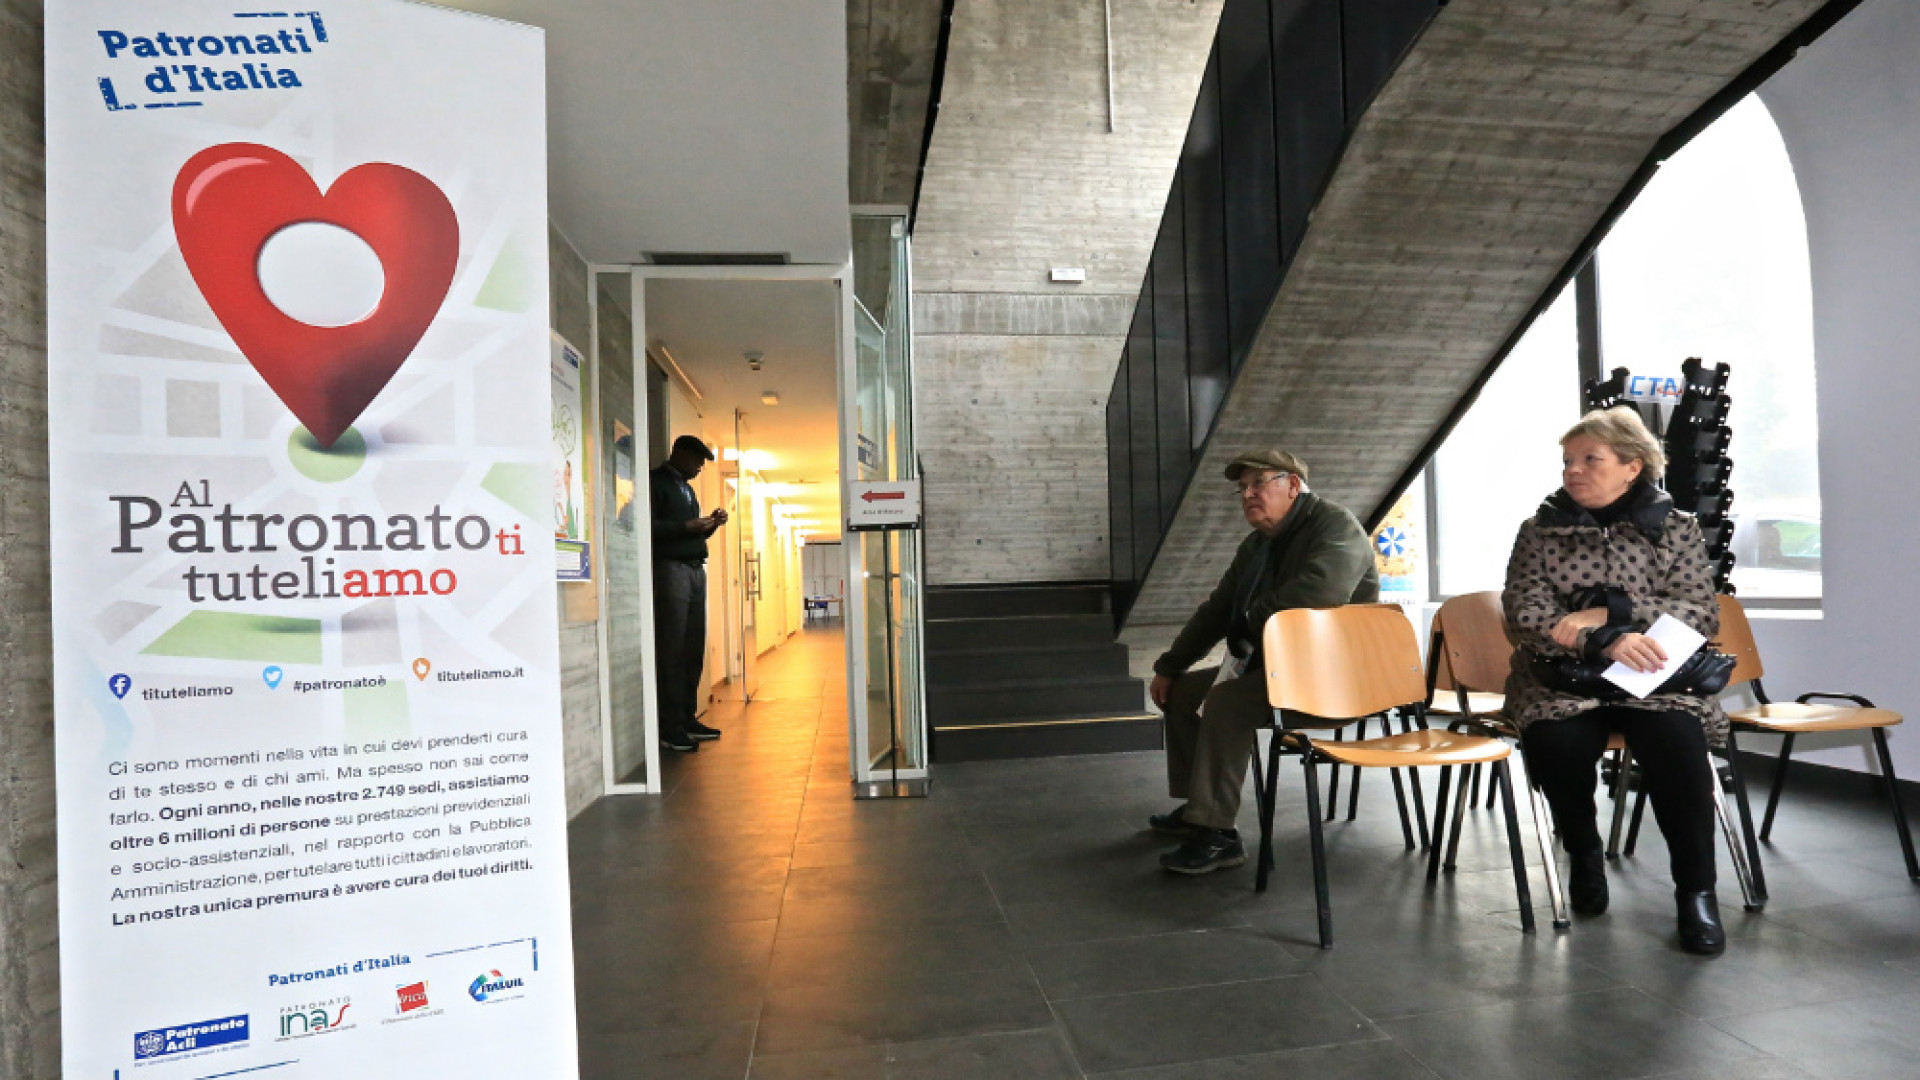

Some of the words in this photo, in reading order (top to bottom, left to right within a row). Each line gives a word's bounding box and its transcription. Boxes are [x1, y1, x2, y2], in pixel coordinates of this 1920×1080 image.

[98, 27, 311, 58] Patronati
[144, 62, 302, 94] d'Italia
[1630, 376, 1679, 397] CTA
[171, 479, 213, 507] Al
[109, 495, 491, 554] Patronato
[495, 524, 525, 555] ti
[182, 556, 458, 602] tuteliamo
[142, 683, 234, 700] tituteliamo
[293, 675, 387, 696] #patronatoè
[437, 667, 525, 682] tituteliamo.it
[109, 761, 128, 775] Ci
[134, 760, 179, 774] sono
[185, 750, 260, 770] momenti
[266, 747, 304, 763] nella
[309, 745, 339, 759] vita
[343, 743, 357, 755] in
[363, 740, 387, 754] cui
[391, 737, 423, 751] devi
[427, 731, 493, 750] prenderti
[497, 730, 528, 742] cura
[109, 787, 126, 801] di
[134, 786, 151, 799] te
[159, 780, 217, 796] stesso
[225, 779, 235, 789] e
[242, 775, 258, 788] di
[264, 771, 289, 786] chi
[296, 769, 329, 783] ami.
[337, 766, 362, 780] Ma
[368, 761, 423, 778] spesso
[430, 758, 457, 770] non
[463, 754, 483, 767] sai
[489, 752, 529, 765] come
[109, 810, 155, 826] farlo.
[159, 804, 203, 821] Ogni
[207, 802, 257, 816] anno,
[260, 795, 302, 811] nelle
[305, 789, 359, 806] nostre
[362, 784, 405, 800] 2.749
[409, 780, 446, 795] sedi,
[448, 774, 529, 791] assistiamo
[110, 835, 154, 850] oltre
[159, 832, 170, 845] 6
[174, 824, 235, 843] milioni
[240, 822, 256, 836] di
[260, 815, 331, 837] persone
[335, 815, 353, 826] su
[357, 803, 439, 826] prestazioni
[443, 793, 531, 816] previdenziali
[110, 865, 121, 876] e
[132, 843, 295, 874] socio-assistenziali,
[305, 838, 328, 853] nel
[337, 830, 404, 849] rapporto
[413, 827, 440, 840] con
[449, 823, 461, 835] la
[470, 816, 532, 833] Pubblica
[110, 872, 262, 901] Amministrazione,
[355, 854, 384, 870] tutti
[392, 845, 450, 866] cittadini
[112, 912, 135, 926] La
[139, 903, 200, 922] nostra
[203, 896, 252, 913] unica
[257, 886, 329, 909] premura
[332, 884, 342, 896] è
[345, 878, 391, 894] avere
[394, 873, 429, 887] cura
[432, 869, 456, 882] dei
[459, 864, 488, 879] tuoi
[490, 857, 533, 875] diritti.
[269, 963, 348, 986] Patronati
[353, 953, 411, 973] d'Italia
[166, 1018, 246, 1041] Patronato
